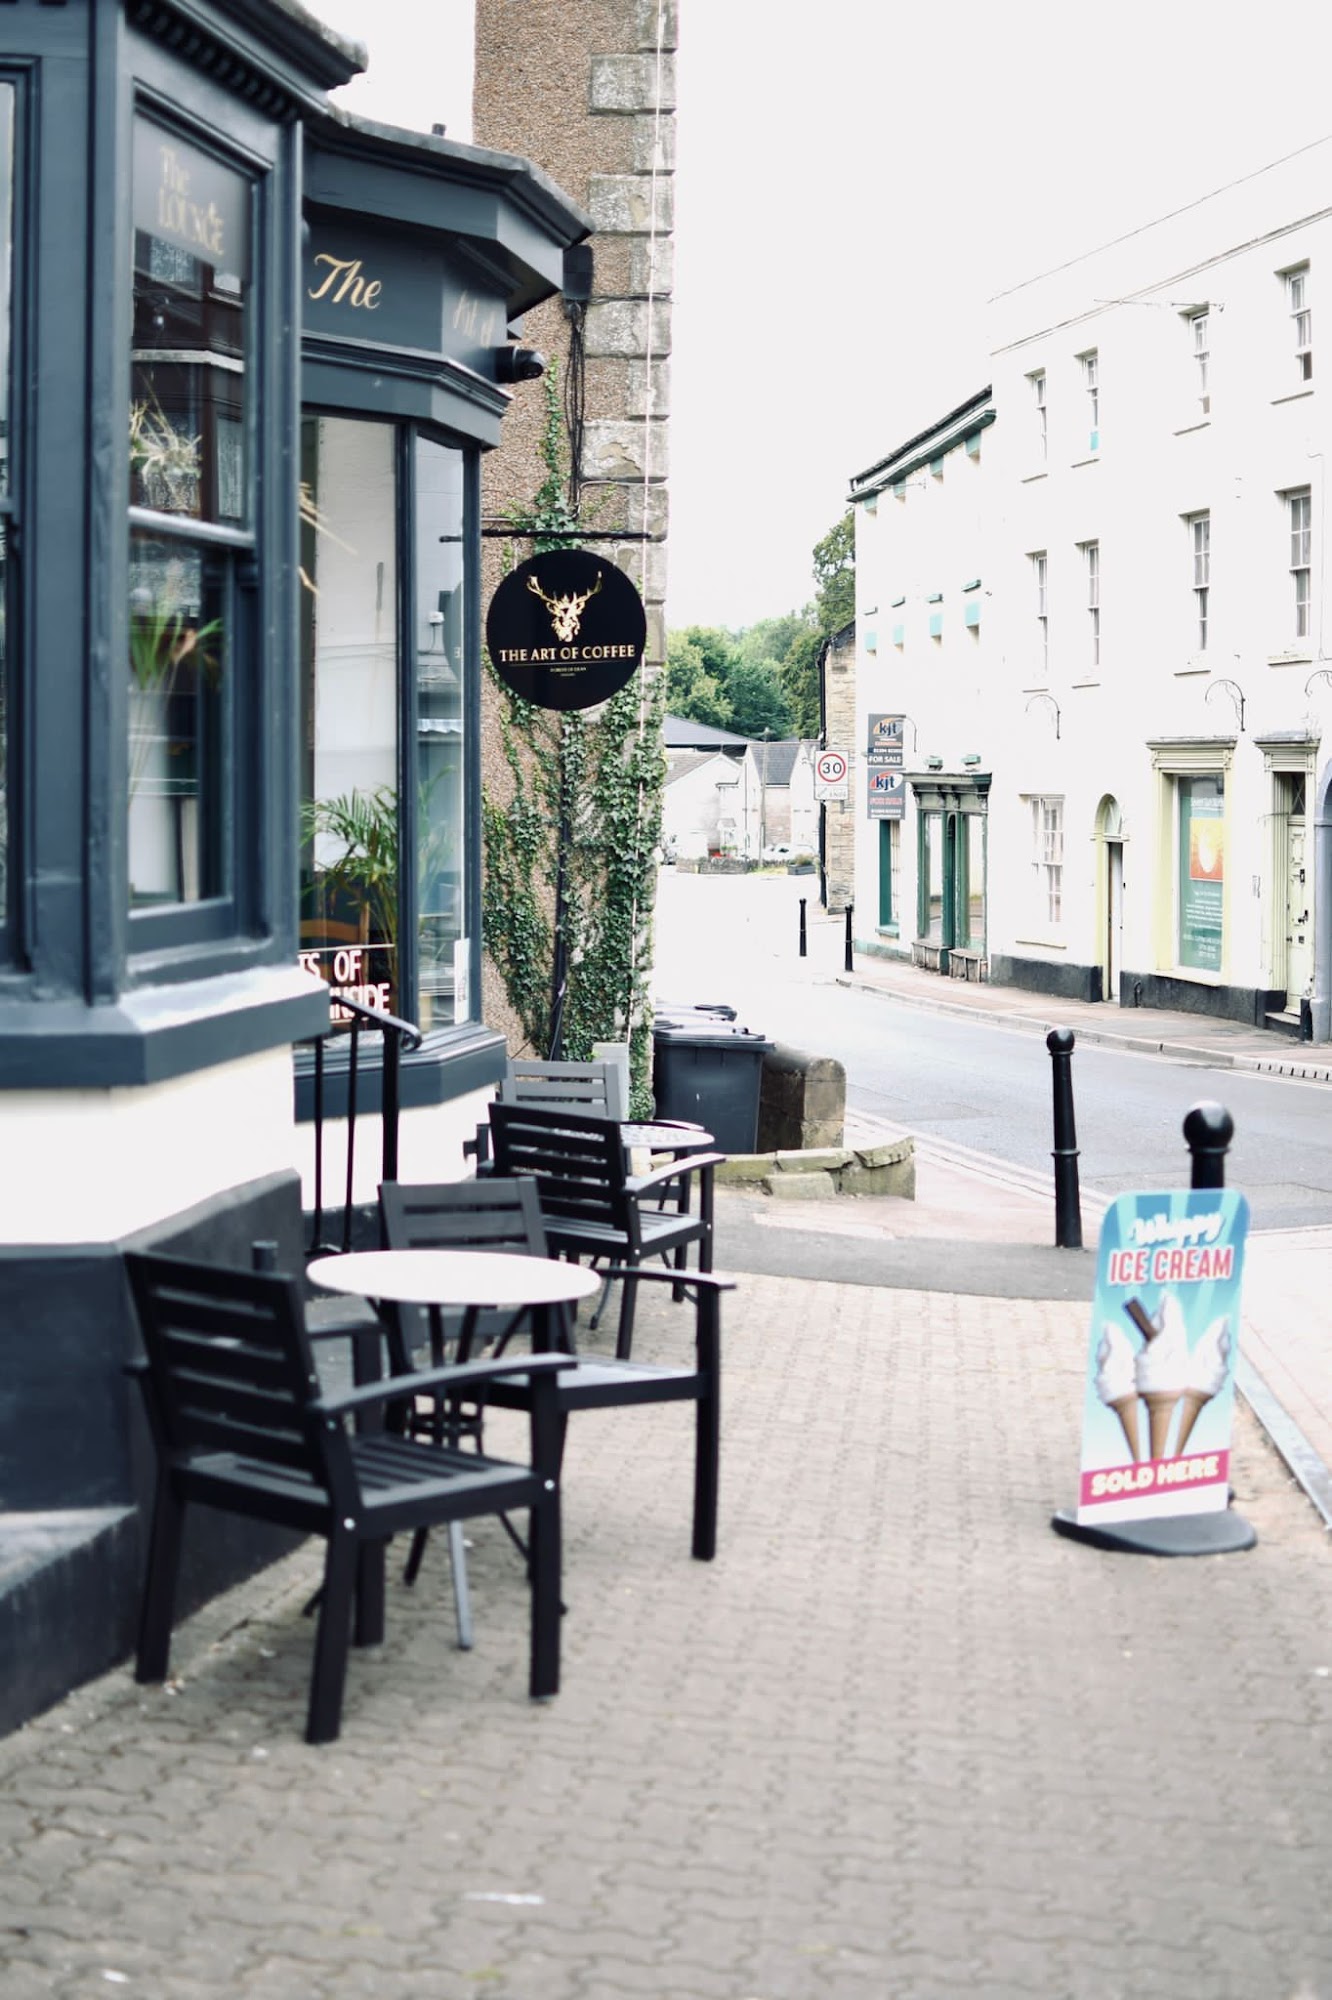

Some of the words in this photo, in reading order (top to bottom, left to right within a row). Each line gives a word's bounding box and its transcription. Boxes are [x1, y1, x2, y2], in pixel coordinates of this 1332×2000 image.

[308, 253, 382, 309] The
[500, 649, 527, 662] THE
[530, 648, 556, 660] ART
[560, 647, 579, 660] OF
[582, 645, 635, 658] COFFEE
[880, 722, 896, 736] kjt
[823, 762, 842, 774] 30
[876, 775, 895, 791] kjt
[334, 950, 362, 982] OF
[1110, 1250, 1148, 1282] ICE
[1153, 1247, 1232, 1281] CREAM
[1091, 1467, 1154, 1497] SOLD
[1157, 1456, 1219, 1485] HERE
